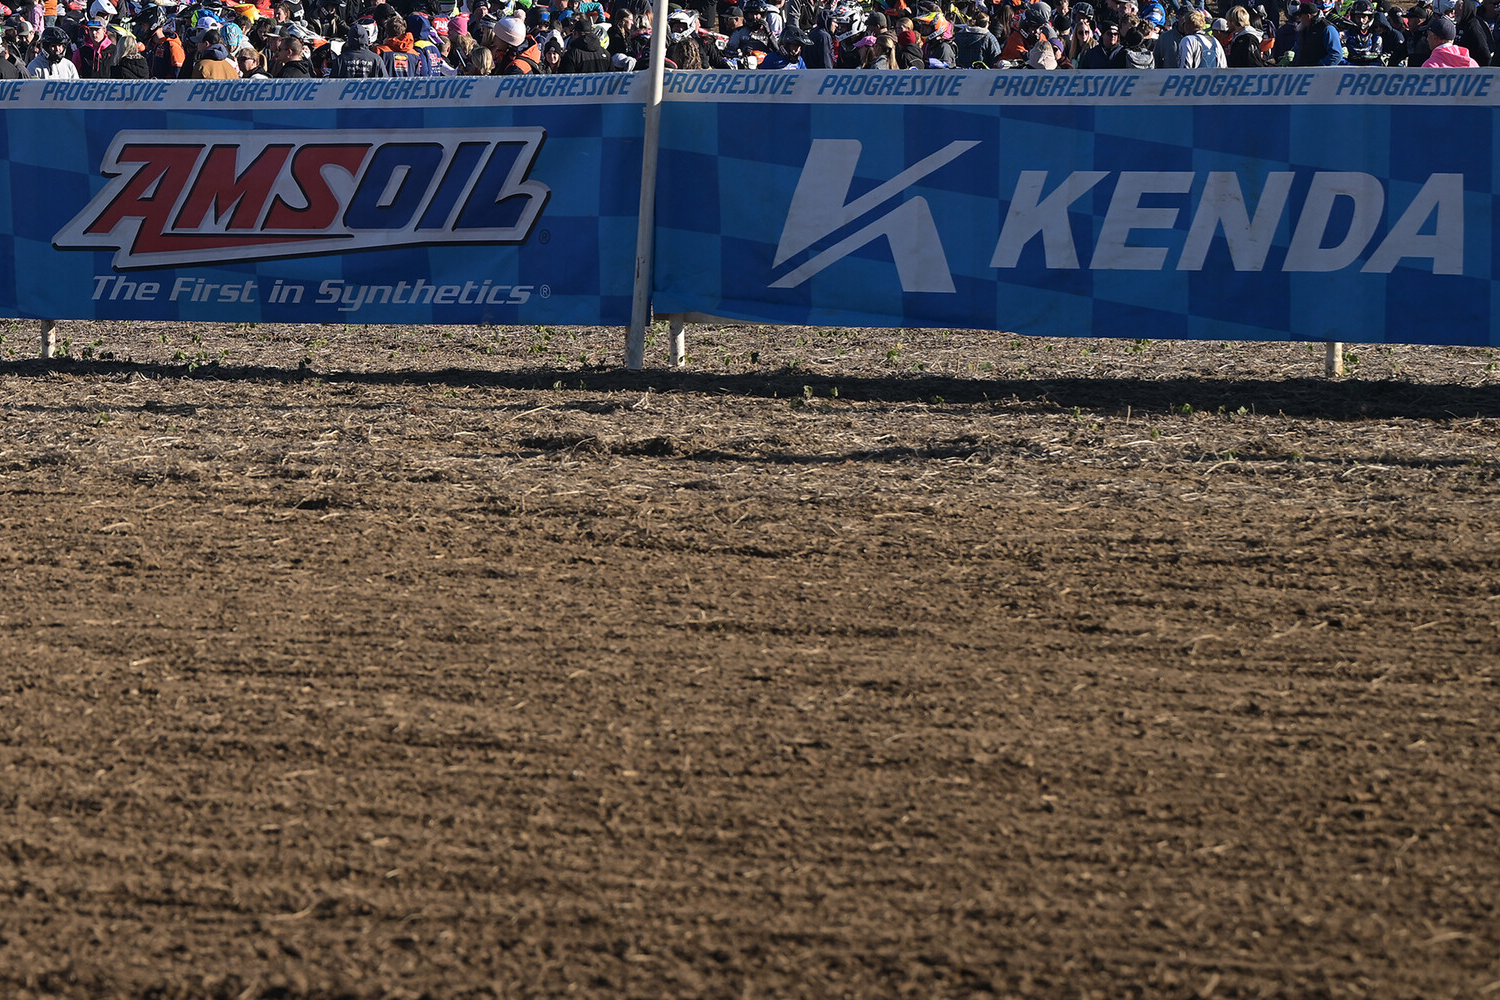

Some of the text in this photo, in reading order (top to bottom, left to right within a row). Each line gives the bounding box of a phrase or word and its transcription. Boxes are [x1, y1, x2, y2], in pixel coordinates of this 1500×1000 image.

[40, 80, 169, 101] PROGRESSIVE
[188, 80, 320, 102] PROGRESSIVE
[339, 78, 475, 100] PROGRESSIVE
[495, 74, 635, 98] PROGRESSIVE
[818, 74, 965, 96] PROGRESSIVE
[989, 74, 1140, 96] PROGRESSIVE
[1159, 73, 1312, 96] PROGRESSIVE
[1335, 72, 1494, 96] PROGRESSIVE
[70, 137, 540, 260] AMSOIL
[990, 171, 1464, 275] KENDA
[91, 275, 534, 311] The First in Synthetics
